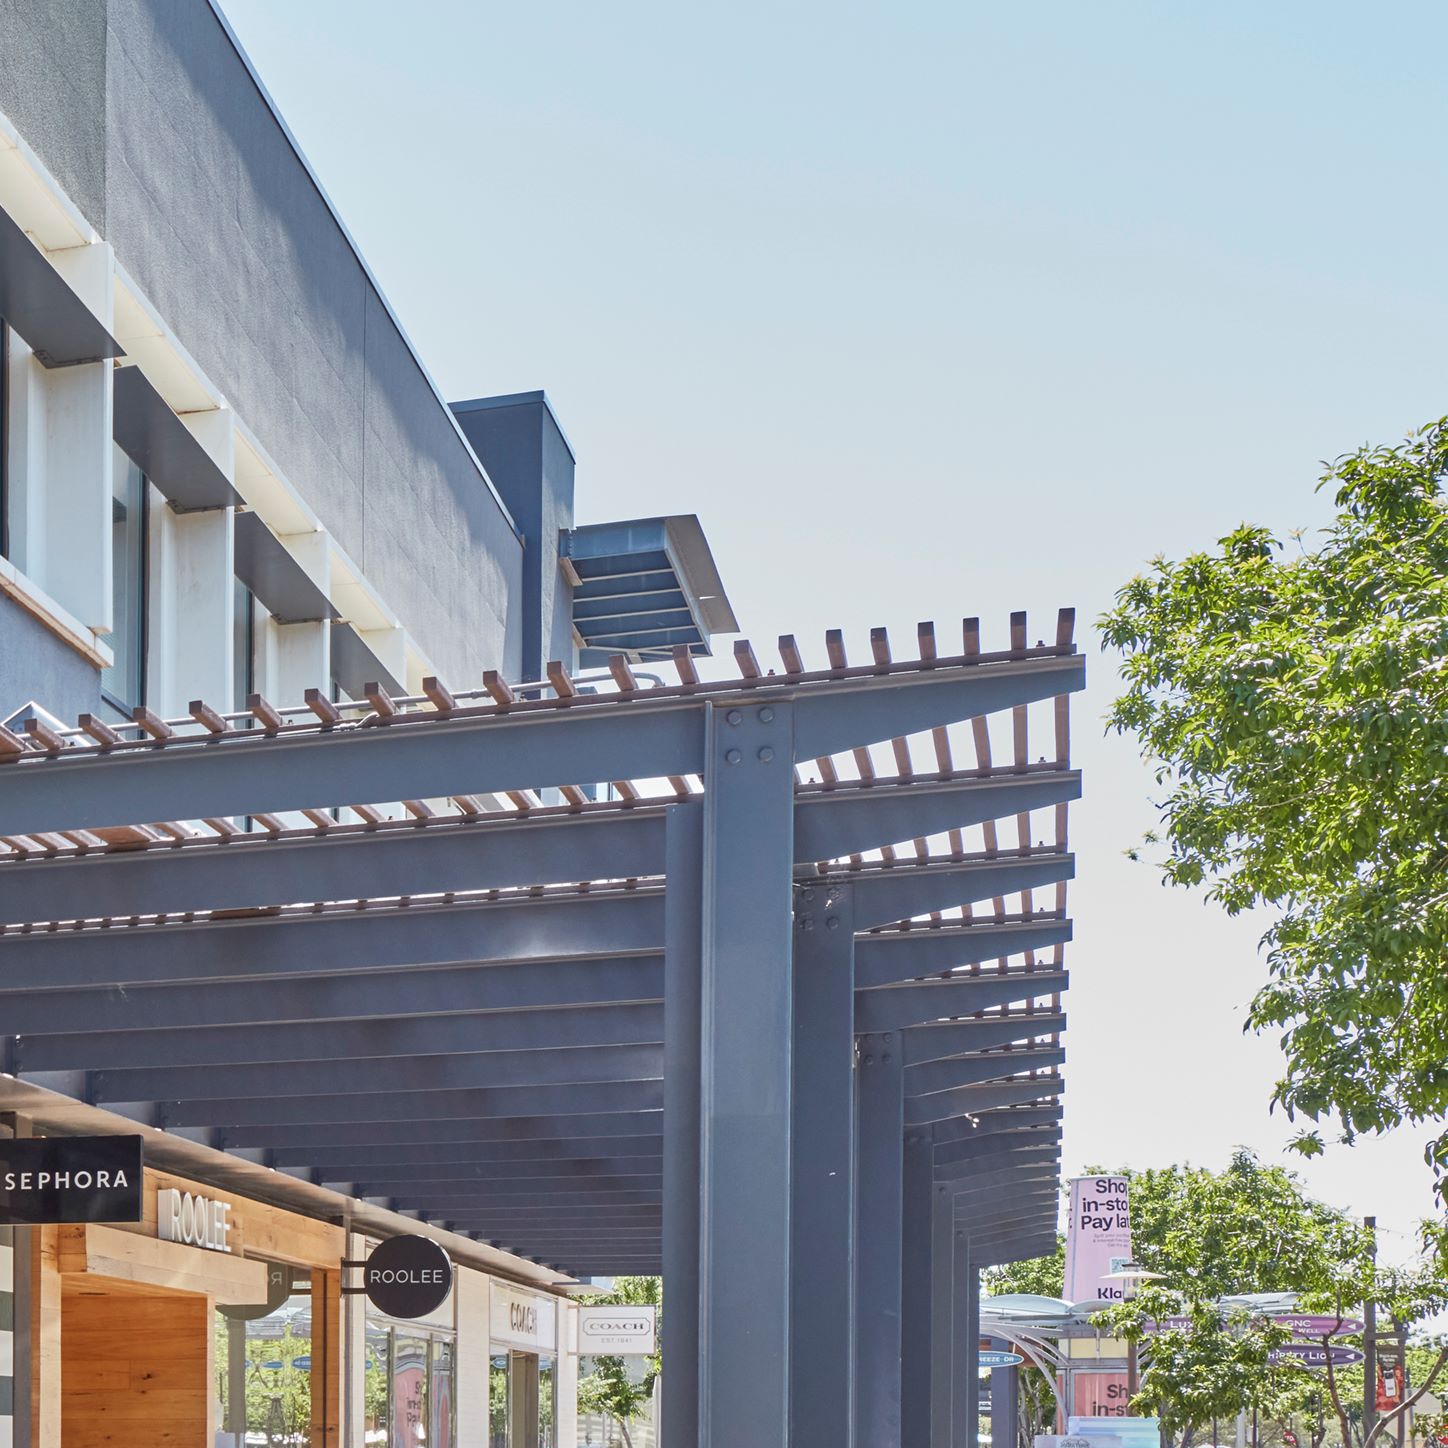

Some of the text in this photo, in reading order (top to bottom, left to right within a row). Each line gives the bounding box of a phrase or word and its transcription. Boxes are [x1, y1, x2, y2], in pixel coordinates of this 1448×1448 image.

[5, 1169, 129, 1190] SEPHORA
[158, 1188, 232, 1252] ROOLEE
[1081, 1215, 1113, 1232] Pay
[370, 1269, 443, 1284] ROOLEE
[509, 1302, 538, 1335] COACH
[589, 1322, 644, 1331] COACH
